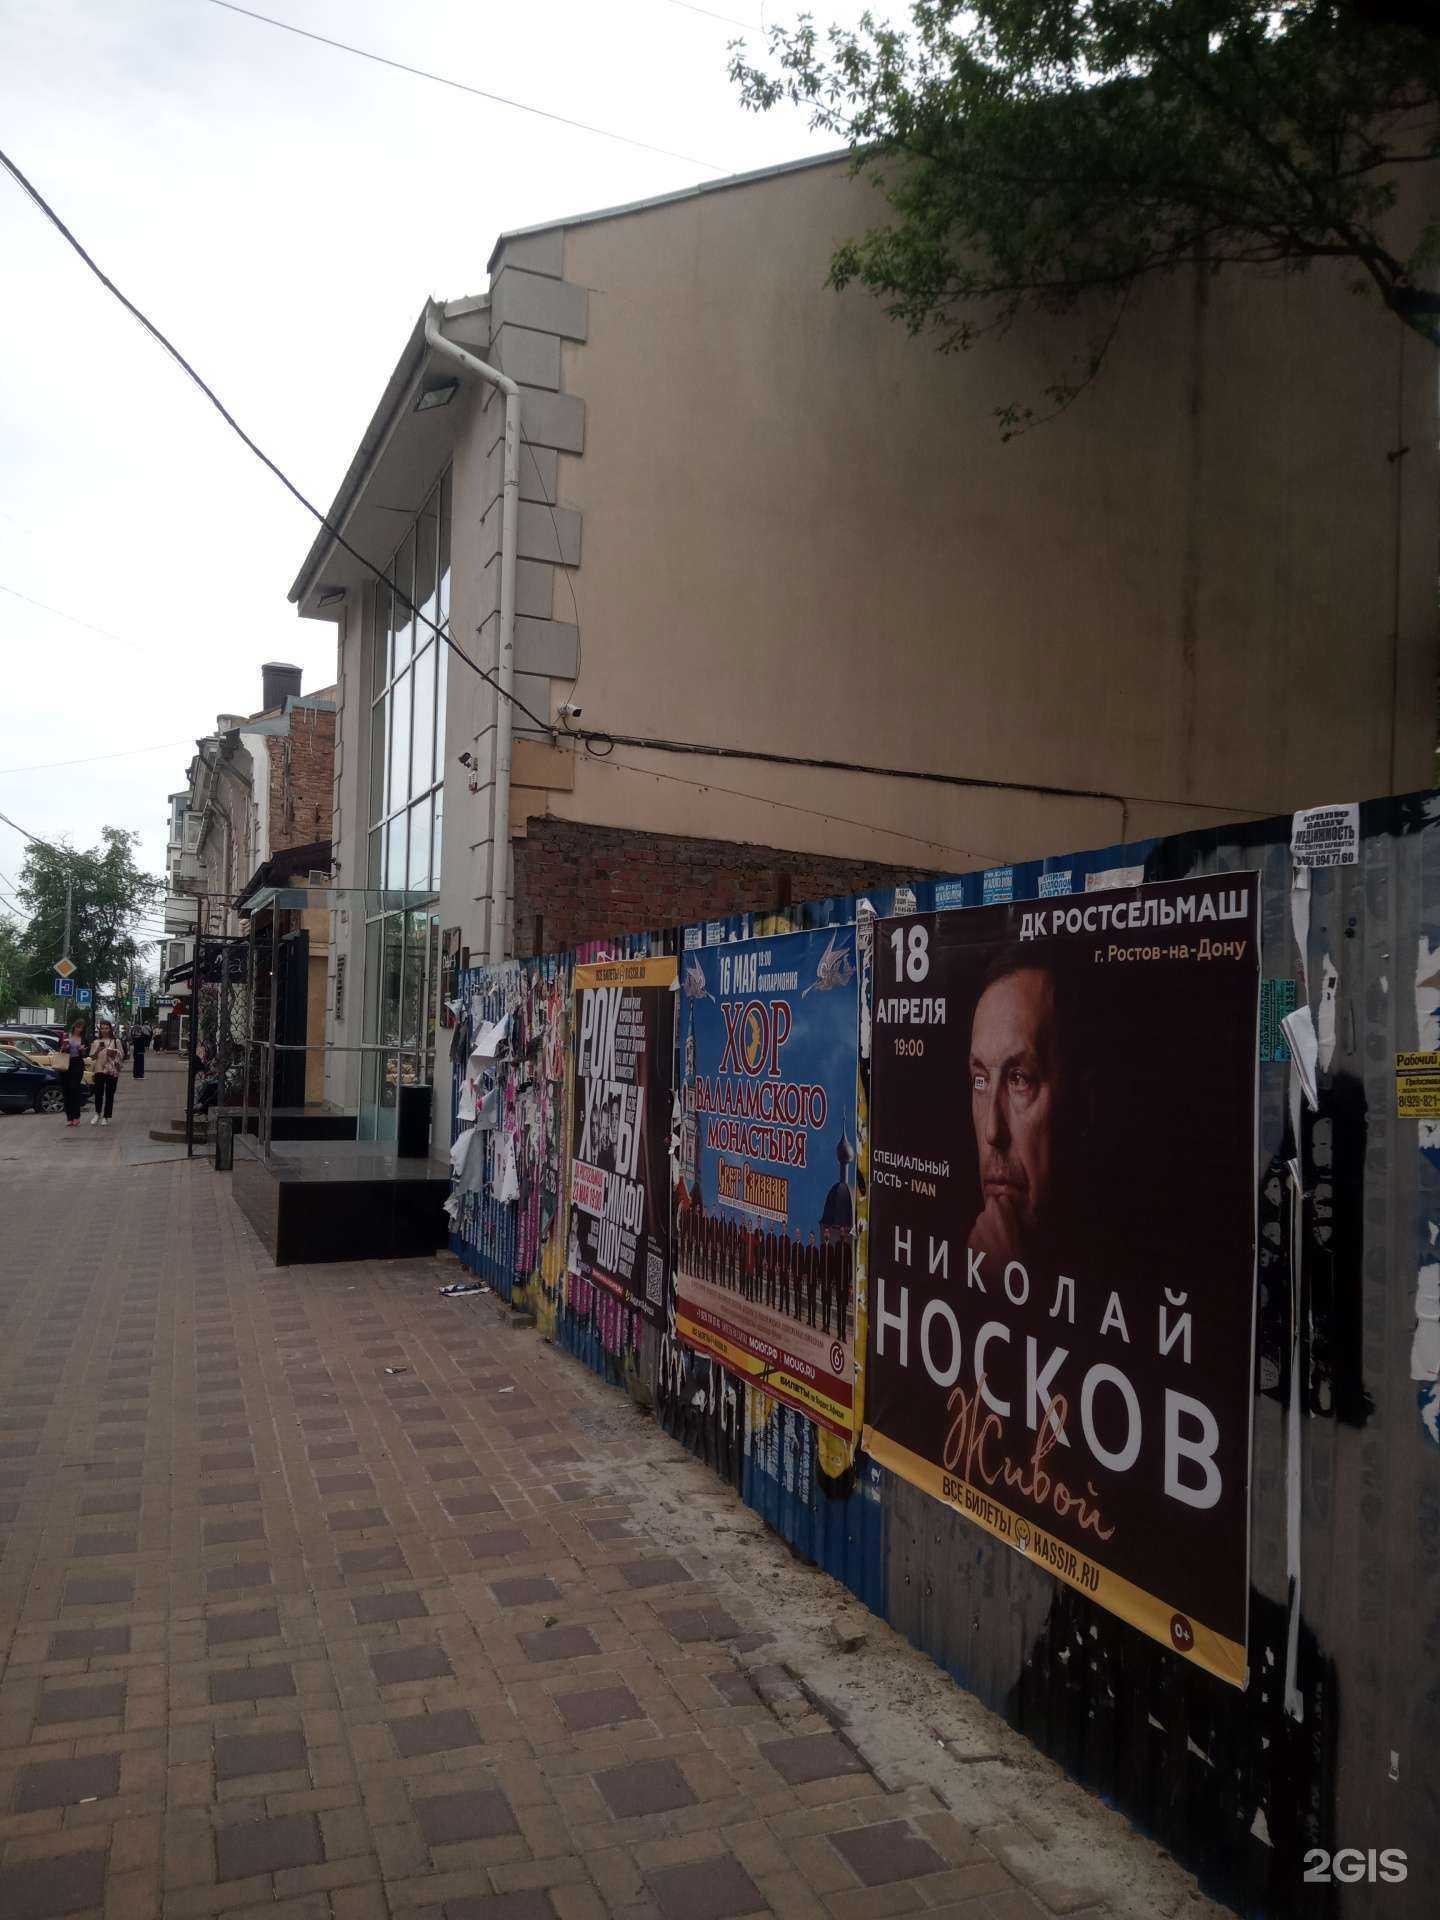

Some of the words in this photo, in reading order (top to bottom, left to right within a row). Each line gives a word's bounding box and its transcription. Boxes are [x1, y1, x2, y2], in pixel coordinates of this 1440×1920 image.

[1019, 911, 1047, 941] ДК
[1052, 889, 1248, 934] РОСТСЕЛЬМАШ
[720, 956, 730, 996] 16
[733, 952, 758, 995] МАЯ
[891, 924, 930, 983] 18
[1095, 950, 1104, 963] г.
[1108, 938, 1247, 962] Ростов-на-Дону
[578, 987, 624, 1081] РОК
[877, 998, 946, 1025] АПРЕЛЯ
[719, 999, 793, 1078] ХОР
[894, 1038, 924, 1057] 19:00
[695, 1074, 828, 1130] ВАЛААМСКОГО
[706, 1117, 808, 1169] МОНАСТЫРЯ
[873, 1149, 951, 1178] СПЕЦИАЛЬНЫЙ
[873, 1170, 902, 1188] ГОСТЬ
[911, 1178, 936, 1198] IVAN
[597, 1216, 624, 1275] ШОУ
[894, 1225, 1193, 1365] НИКОЛАЙ
[783, 1355, 816, 1380] MOUG.RU
[876, 1277, 1223, 1510] НОСКОВ
[943, 1371, 1117, 1541] Живой
[942, 1475, 964, 1505] ВСЕ
[965, 1485, 1012, 1537] БИЛЕТЫ
[1033, 1536, 1100, 1594] KASSIR.RU
[1174, 1623, 1191, 1641] 0+
